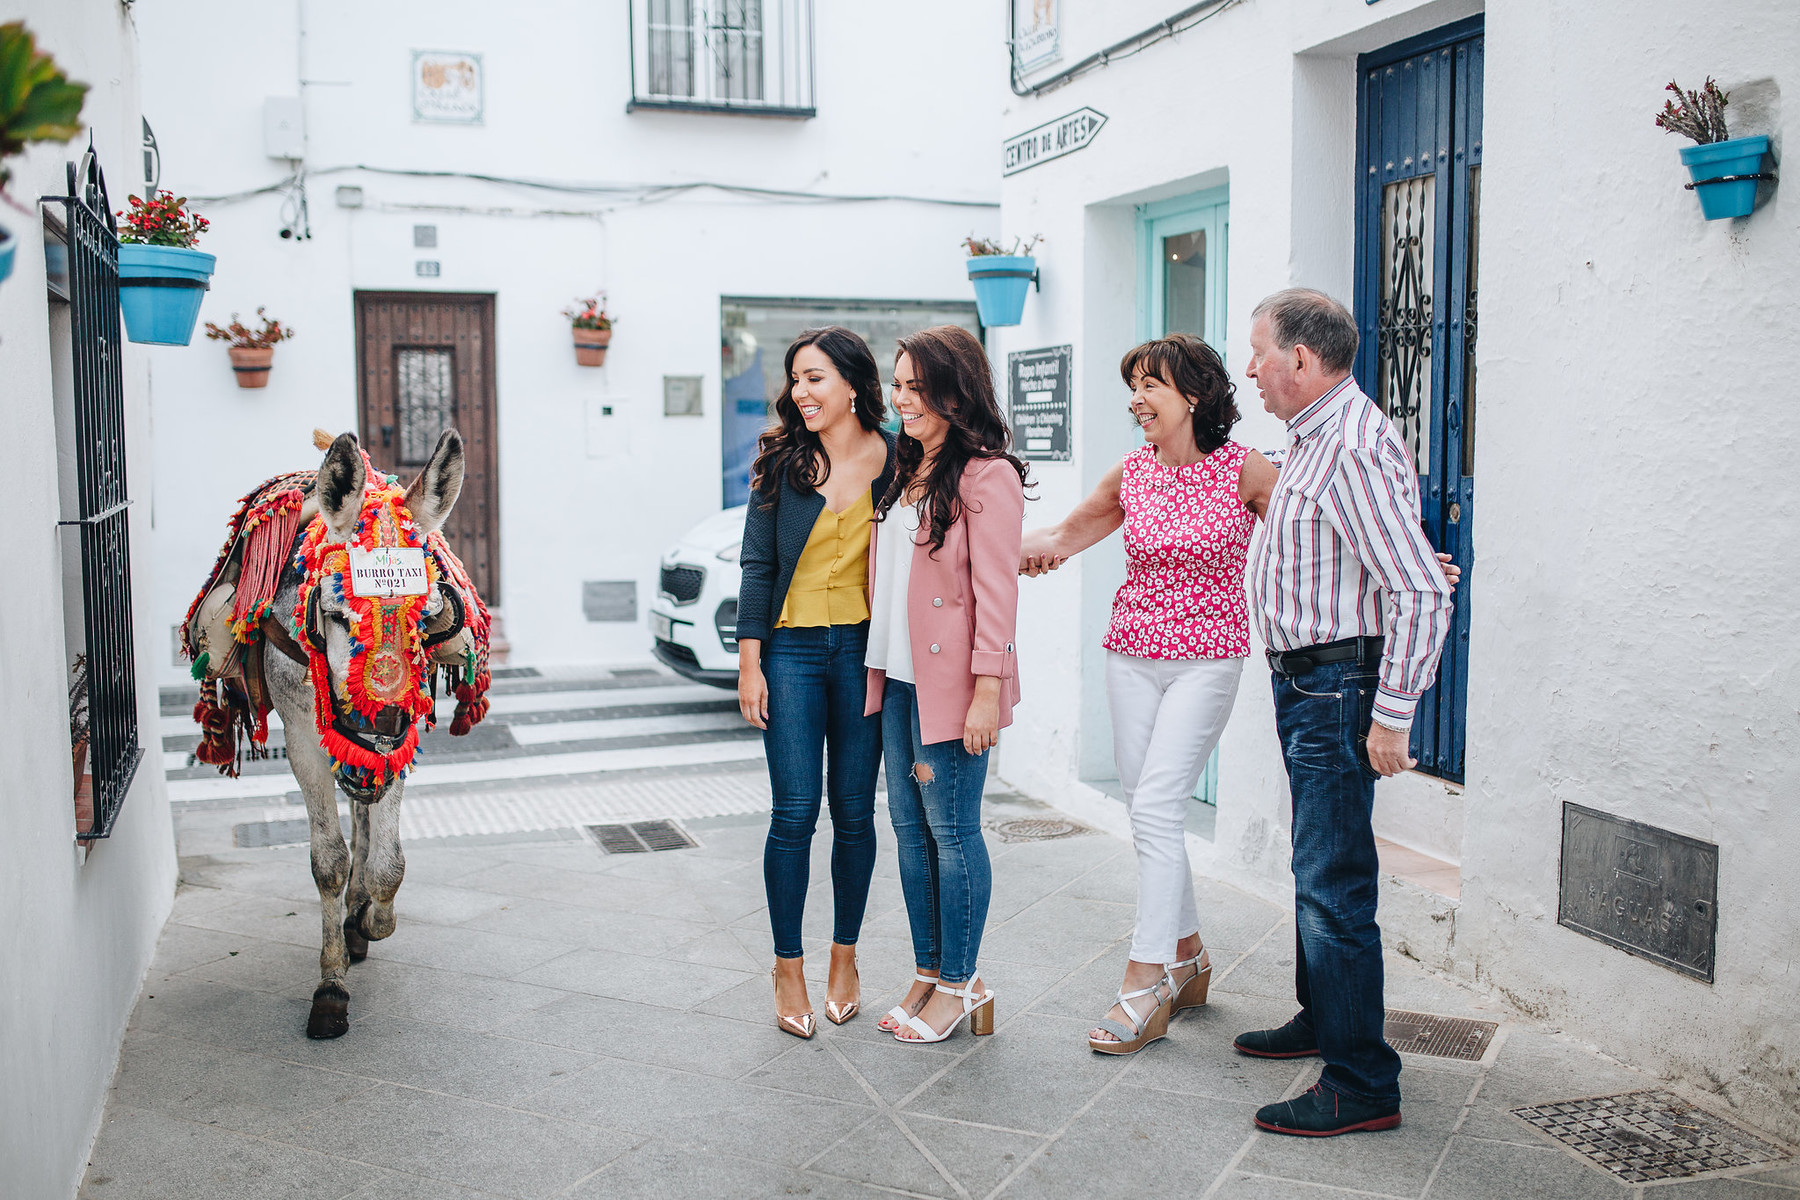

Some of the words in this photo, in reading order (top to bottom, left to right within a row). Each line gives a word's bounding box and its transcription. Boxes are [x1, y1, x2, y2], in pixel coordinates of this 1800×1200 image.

[1006, 136, 1037, 168] CENTRO
[1042, 132, 1051, 153] DE
[1056, 115, 1087, 150] ARTES
[1018, 363, 1035, 380] Ropa
[1035, 359, 1060, 378] Infantil
[376, 554, 402, 567] Mijas
[357, 568, 395, 578] BURRO
[397, 568, 423, 578] TAXI
